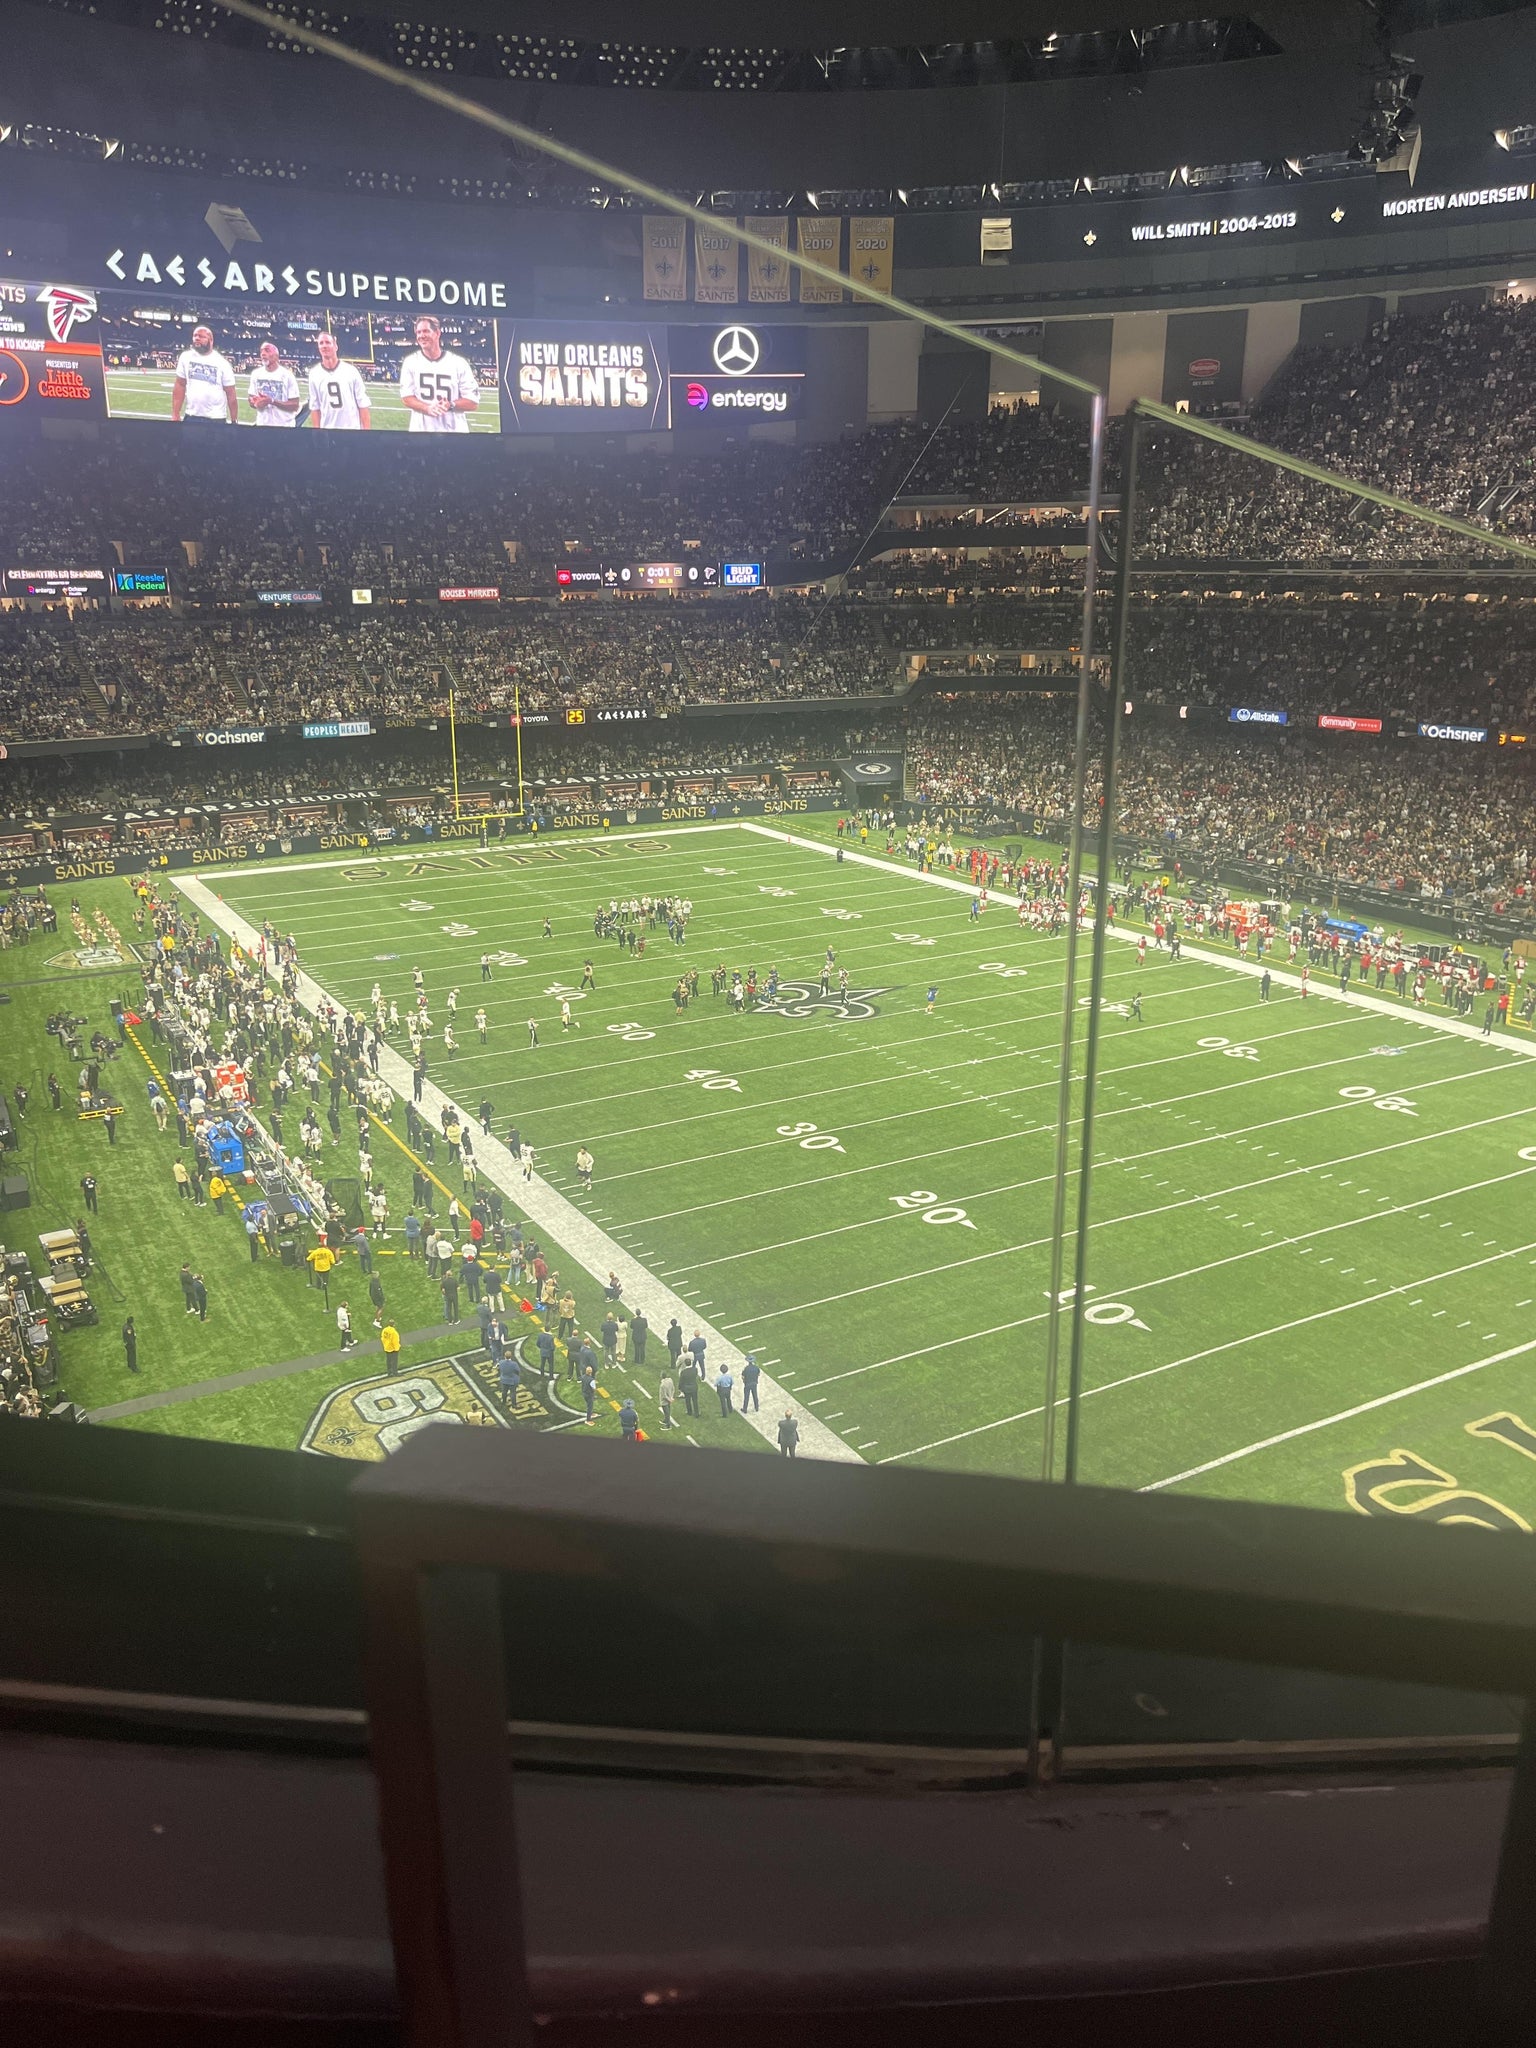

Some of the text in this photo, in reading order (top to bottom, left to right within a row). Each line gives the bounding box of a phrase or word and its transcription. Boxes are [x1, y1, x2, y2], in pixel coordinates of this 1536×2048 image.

[1383, 185, 1529, 217] MORTEN ANDERSEN
[1132, 213, 1297, 241] WILL SMITH 2004-2013
[703, 238, 730, 250] 2017
[805, 238, 834, 250] 2019
[857, 238, 887, 250] 2020
[106, 249, 507, 308] CAESARS SUPERDOME
[520, 343, 644, 367] NEW ORLEANS
[47, 369, 83, 386] Little
[38, 381, 91, 399] Caesars
[420, 373, 451, 401] 55
[519, 365, 649, 408] SAINTS
[327, 381, 342, 409] 9
[712, 388, 787, 412] entergy
[572, 573, 600, 581] TOYOTA
[621, 568, 631, 580] 0
[648, 566, 669, 578] 0:01
[688, 567, 698, 580] 0
[731, 566, 753, 575] BUD
[135, 574, 165, 582] Keesler
[727, 575, 758, 584] LIGHT
[136, 582, 165, 590] Federal
[440, 588, 498, 598] ROUSES MARKETS
[258, 593, 322, 601] VENTURE GLOBAL
[568, 711, 583, 723] 25
[597, 709, 648, 721] CAESARS
[655, 706, 682, 714] SAINTS
[385, 719, 416, 728] SAINTS
[523, 716, 549, 724] TOYOTA
[1321, 716, 1357, 730] Community
[304, 724, 369, 737] PEOPLES HEALTH
[1427, 725, 1485, 742] Ochsner
[205, 731, 265, 745] Ochsner
[500, 767, 733, 788] CAESARS SUPERDOME
[102, 790, 382, 822] CAESARS SUPERDOME
[662, 806, 706, 820] SAINTS
[764, 799, 808, 813] SAINTS
[554, 813, 600, 828] SAINTS
[440, 823, 481, 838] SAINT
[192, 845, 248, 864] SAINTS
[340, 838, 672, 882] SAINTS
[55, 860, 115, 880] SAINTS
[978, 962, 1028, 978] 50
[606, 1022, 656, 1041] 50
[683, 1068, 740, 1091] 40
[776, 1121, 840, 1150] 30
[889, 1190, 968, 1225] 20
